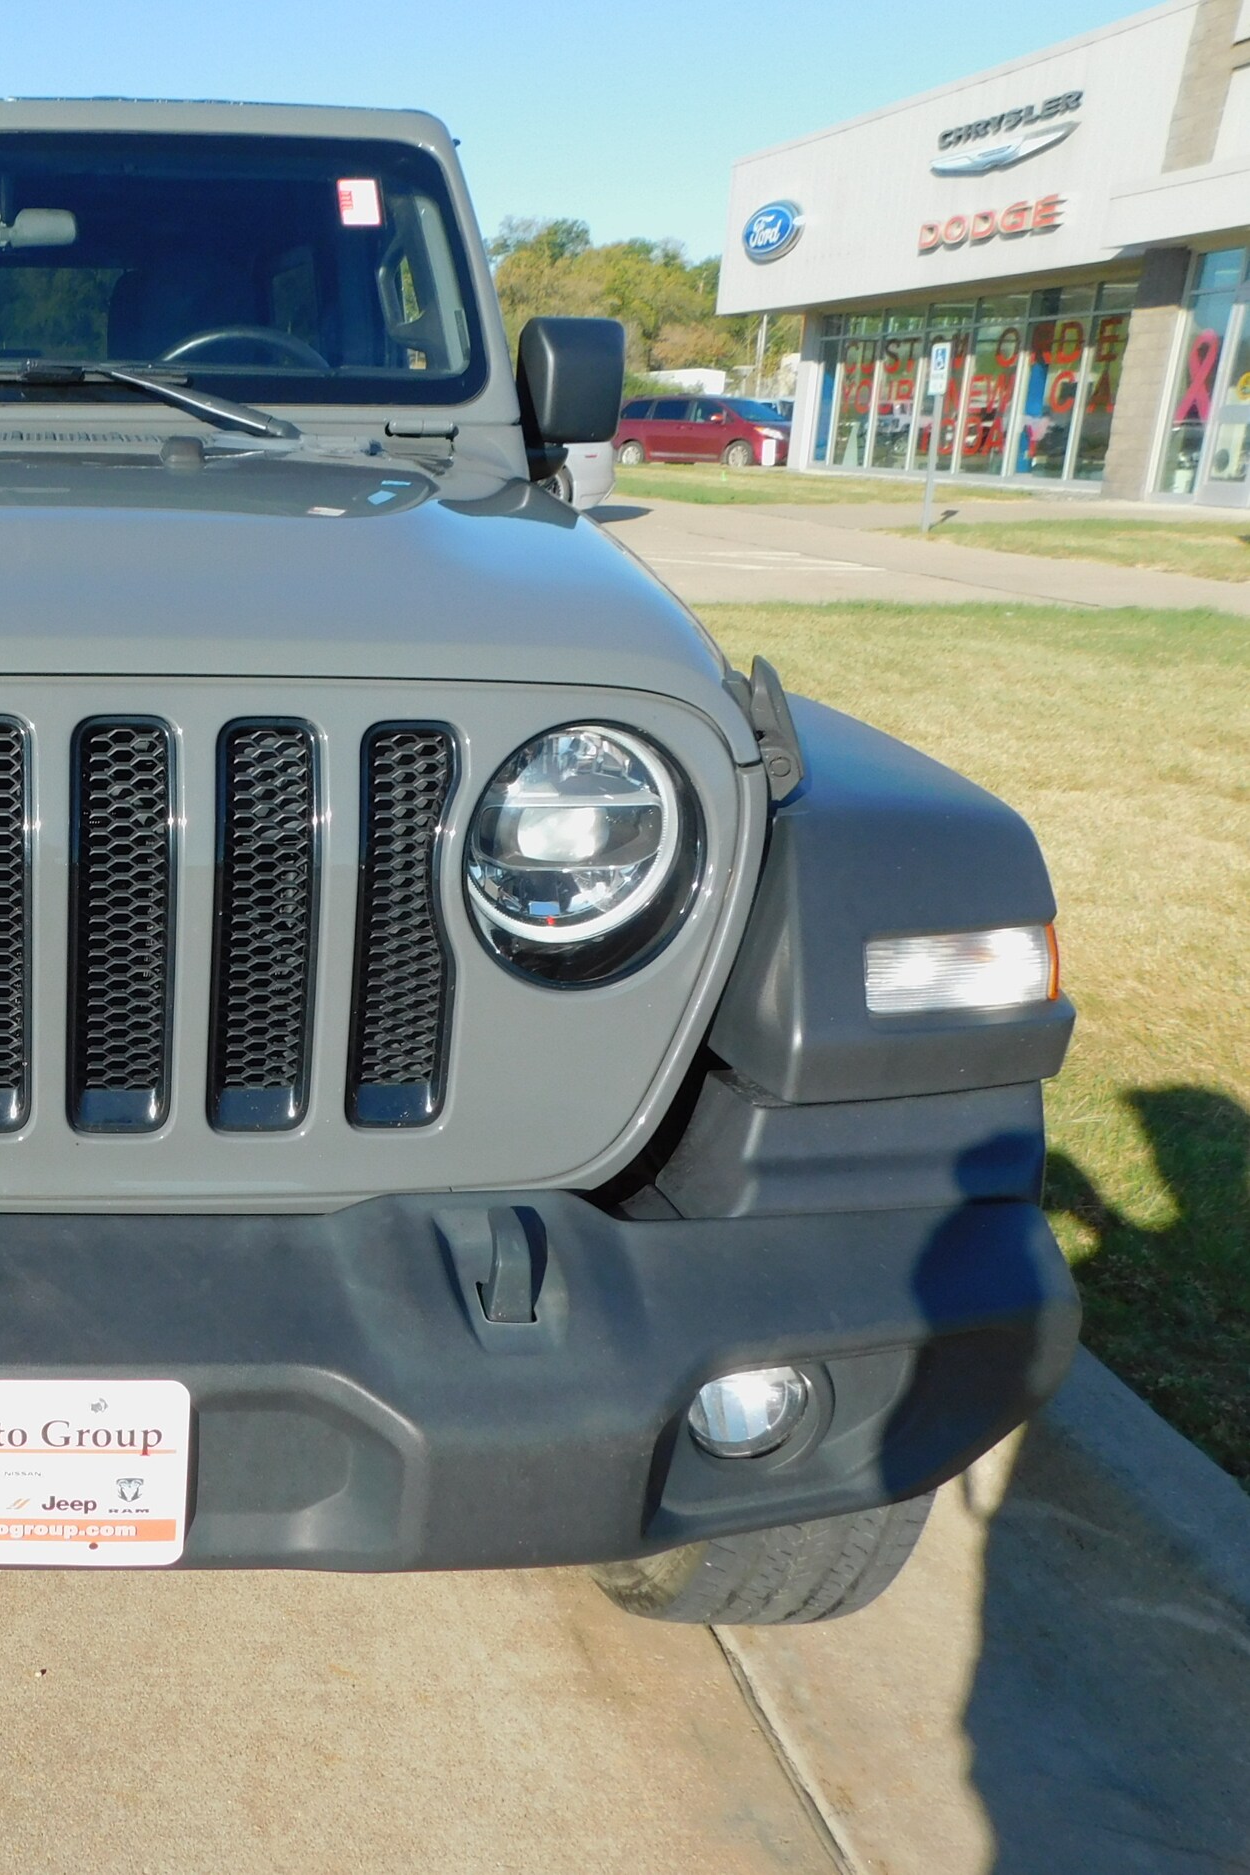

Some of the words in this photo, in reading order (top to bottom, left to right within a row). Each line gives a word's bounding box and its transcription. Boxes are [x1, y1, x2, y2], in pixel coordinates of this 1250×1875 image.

[938, 90, 1083, 150] CHRYSLER
[749, 214, 783, 248] Ford
[917, 193, 1063, 254] DODGE
[943, 373, 1016, 414] NEW
[41, 1420, 163, 1457] Group
[41, 1495, 98, 1514] Jeep
